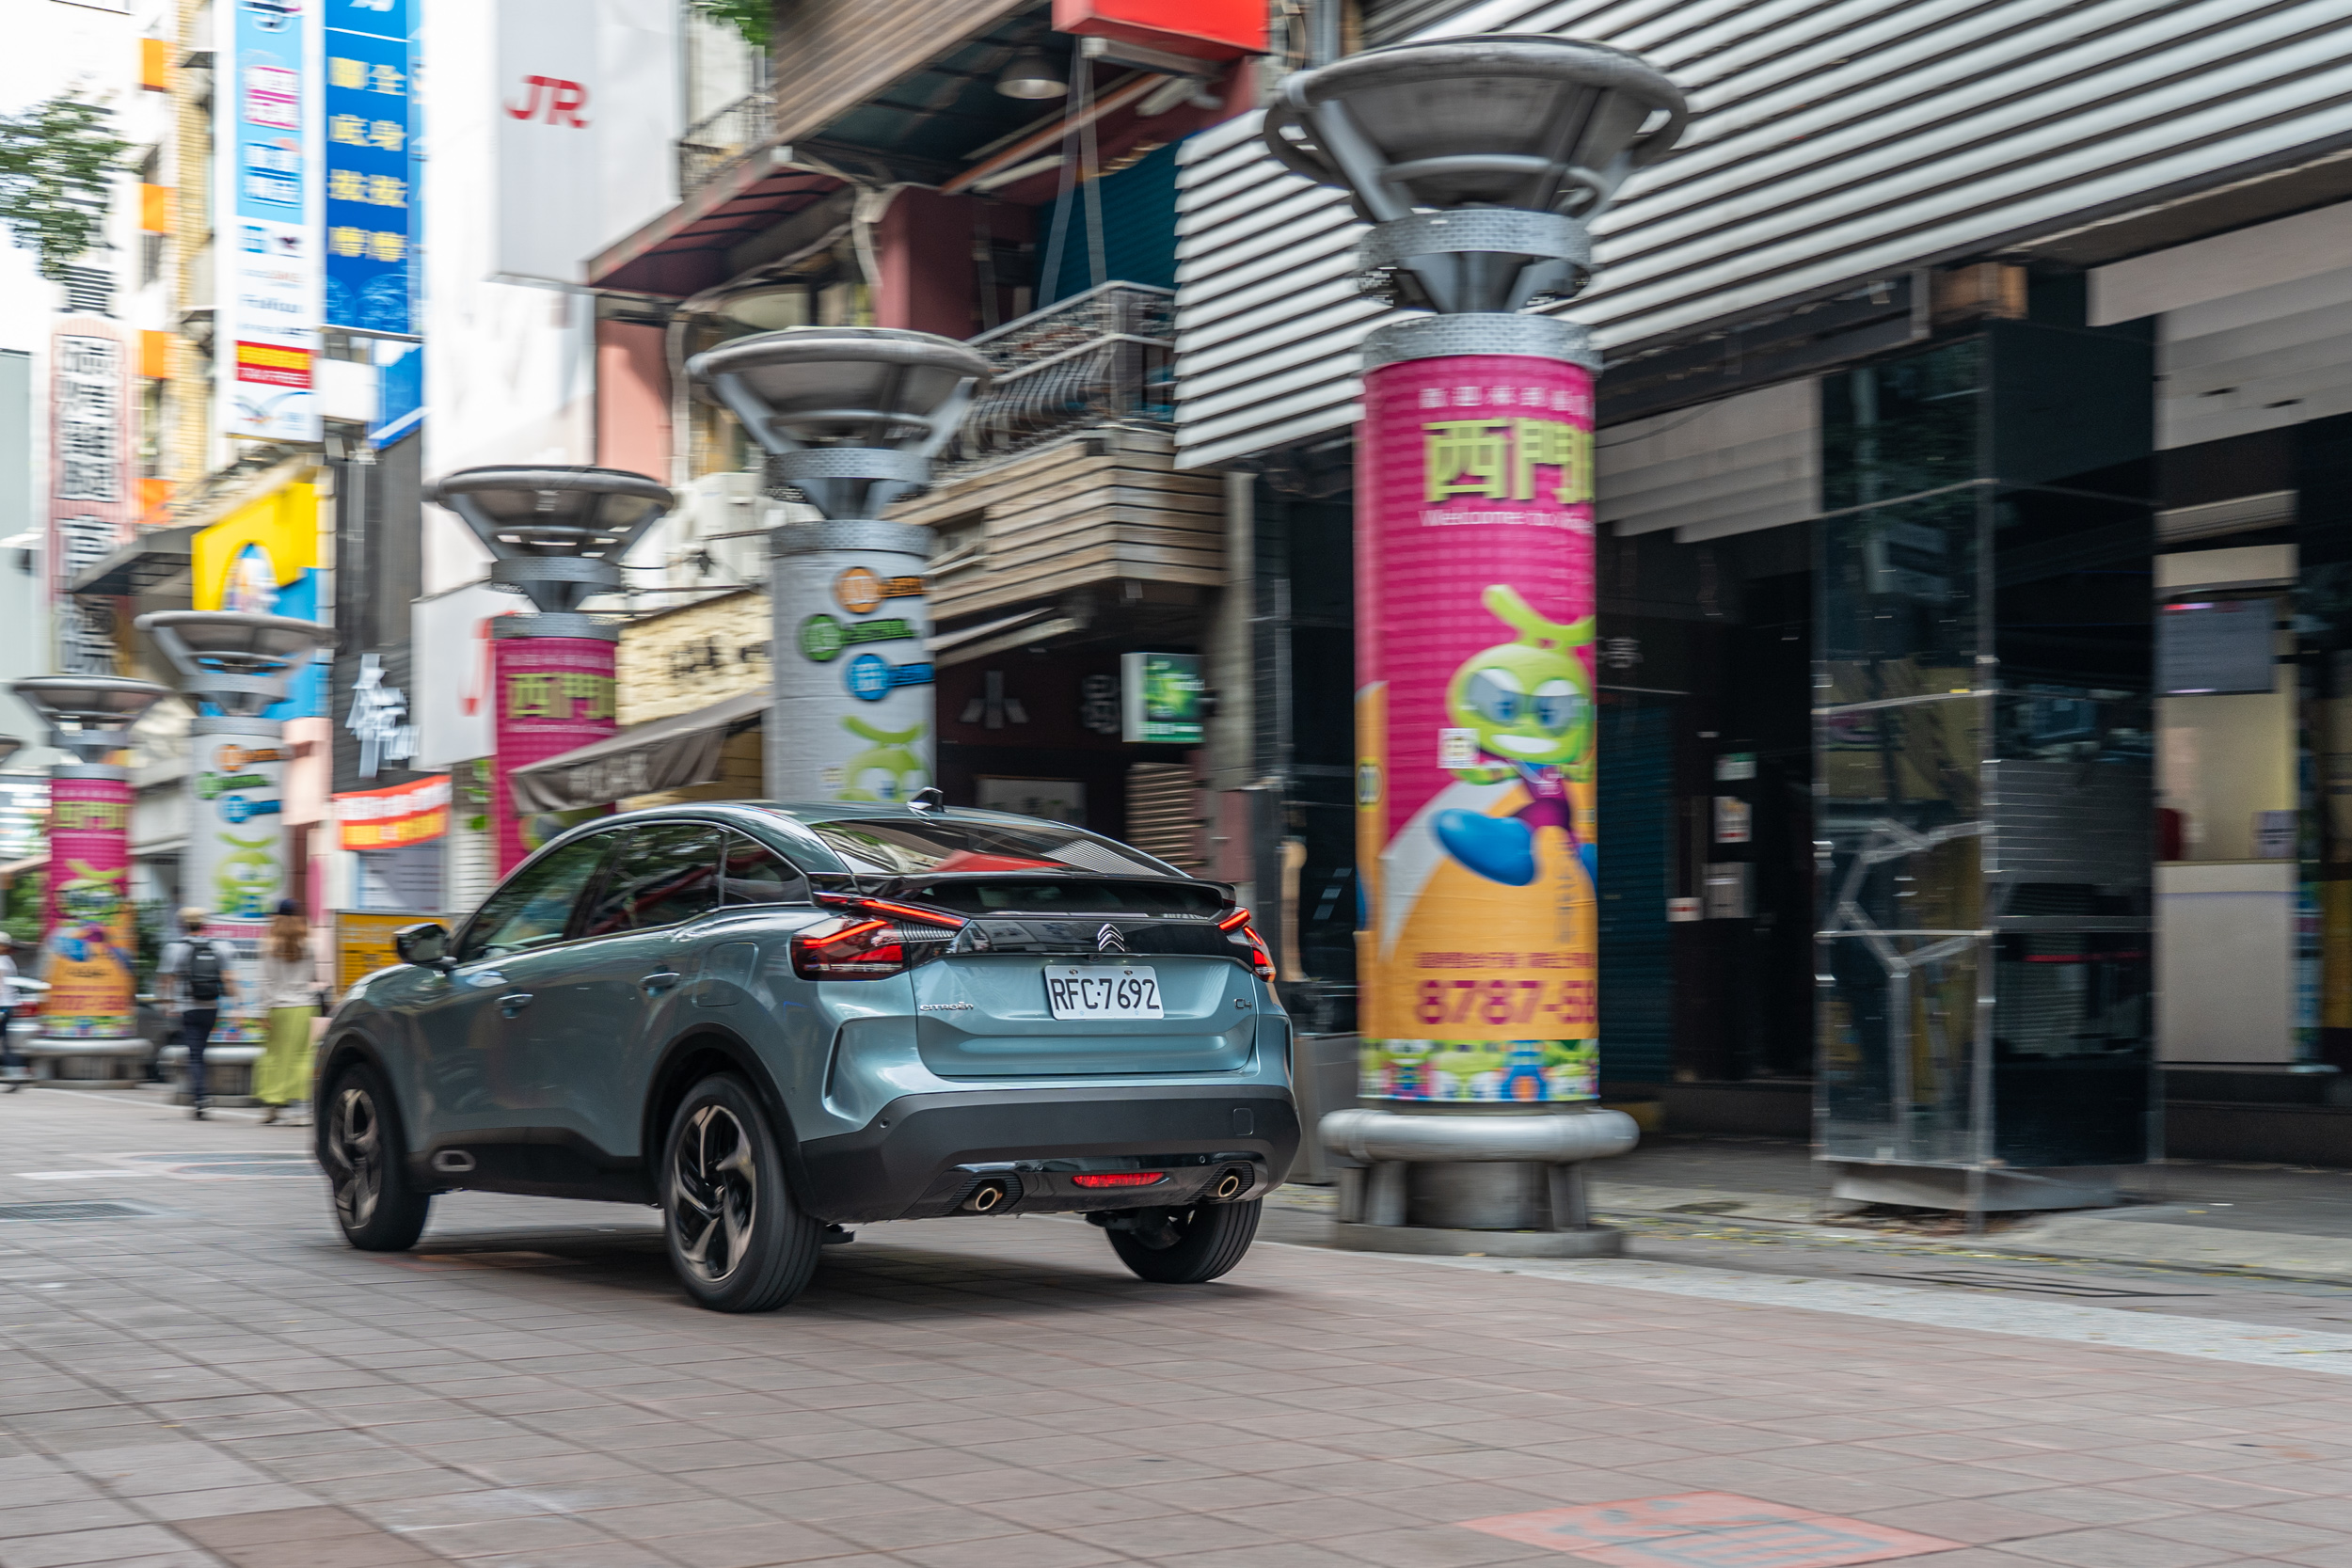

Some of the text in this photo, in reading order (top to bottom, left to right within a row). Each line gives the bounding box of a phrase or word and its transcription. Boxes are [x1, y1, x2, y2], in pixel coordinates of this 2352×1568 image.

[504, 74, 593, 129] JR
[1422, 417, 1596, 504] 西門
[919, 1001, 974, 1011] CITROËN
[1233, 998, 1252, 1010] C4
